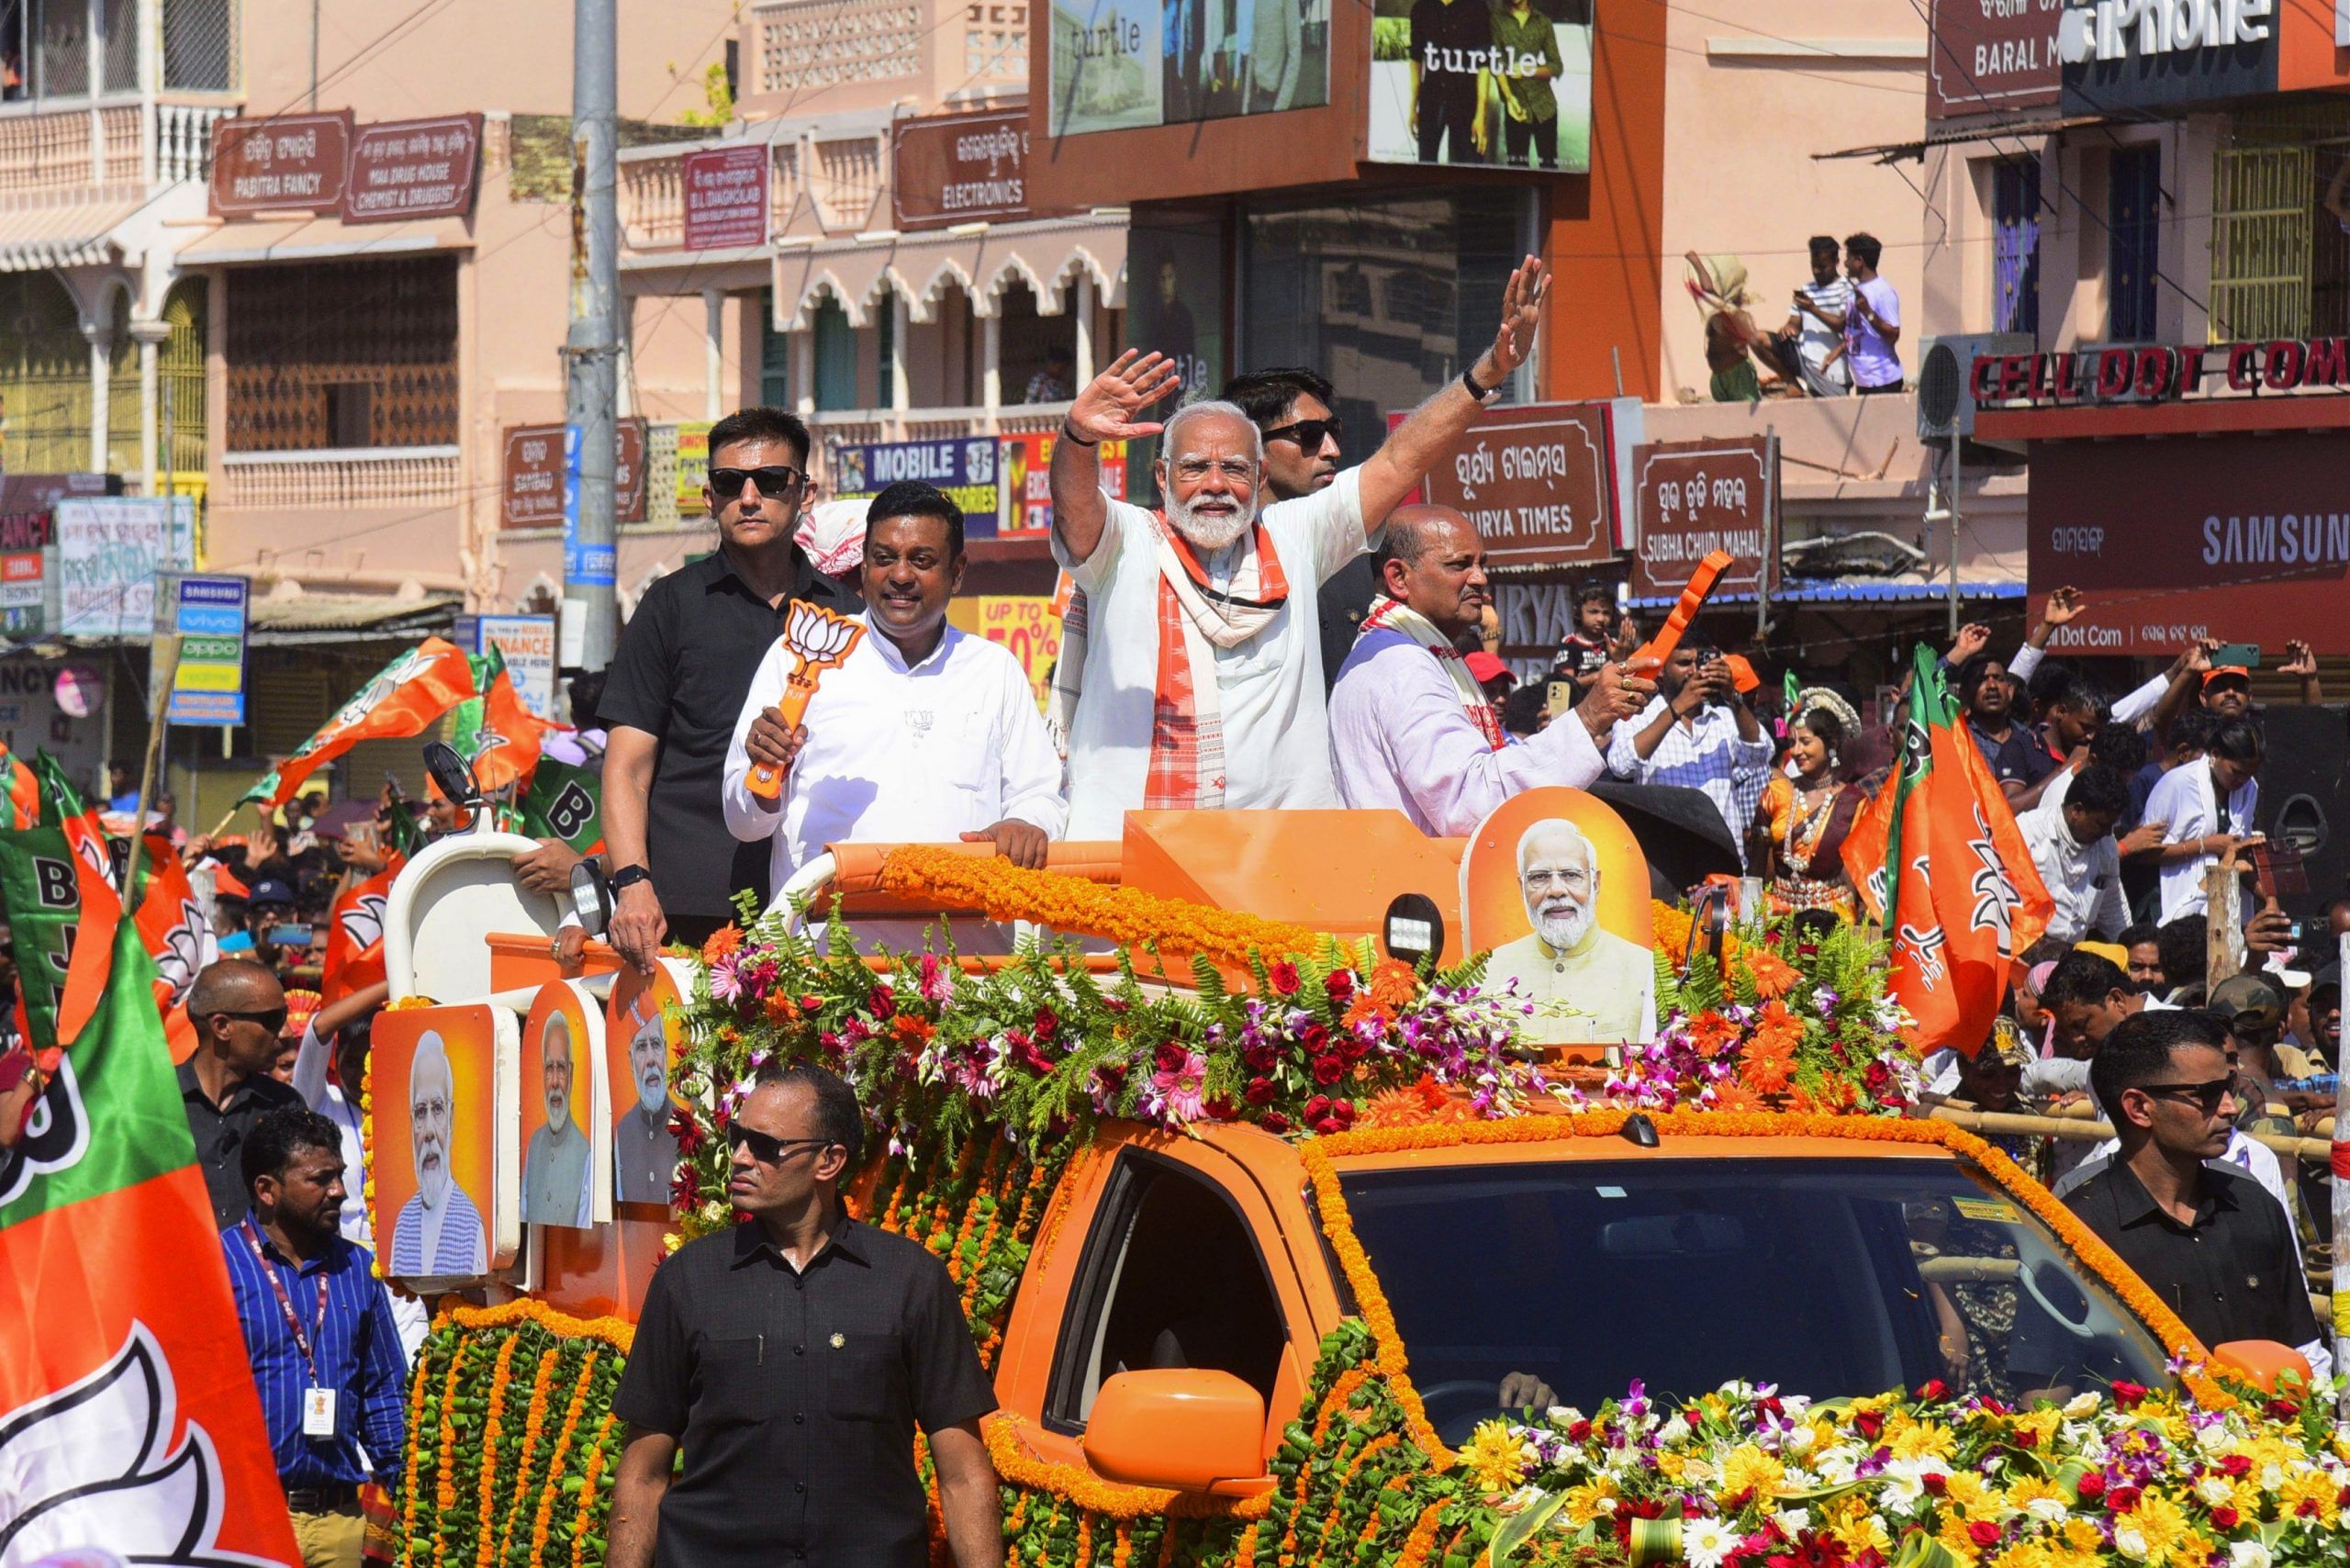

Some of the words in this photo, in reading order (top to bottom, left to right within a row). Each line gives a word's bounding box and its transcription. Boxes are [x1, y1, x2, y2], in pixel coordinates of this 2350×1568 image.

[1071, 18, 1140, 60] turtle
[1424, 41, 1538, 78] turtle
[1975, 38, 2039, 77] BARAL
[234, 175, 280, 198] PABITRA
[283, 172, 322, 196] FANCY
[390, 165, 417, 185] DRUG
[418, 162, 450, 182] HOUSE
[943, 180, 1023, 209] ELECTRONICS
[1969, 352, 2083, 401] CELL
[2098, 346, 2208, 398] DOT
[2228, 337, 2350, 391] COM
[874, 444, 956, 483] MOBILE
[1518, 504, 1572, 535] TIMES
[1647, 533, 1684, 563] SUBHA
[1723, 529, 1762, 558] MAHAL
[185, 584, 240, 600] SAMSUNG
[185, 612, 238, 629] vivo
[986, 602, 1012, 622] UP
[1017, 601, 1042, 622] TO
[184, 640, 238, 657] oppo
[2060, 624, 2086, 646] Dot
[2088, 624, 2122, 646] Com
